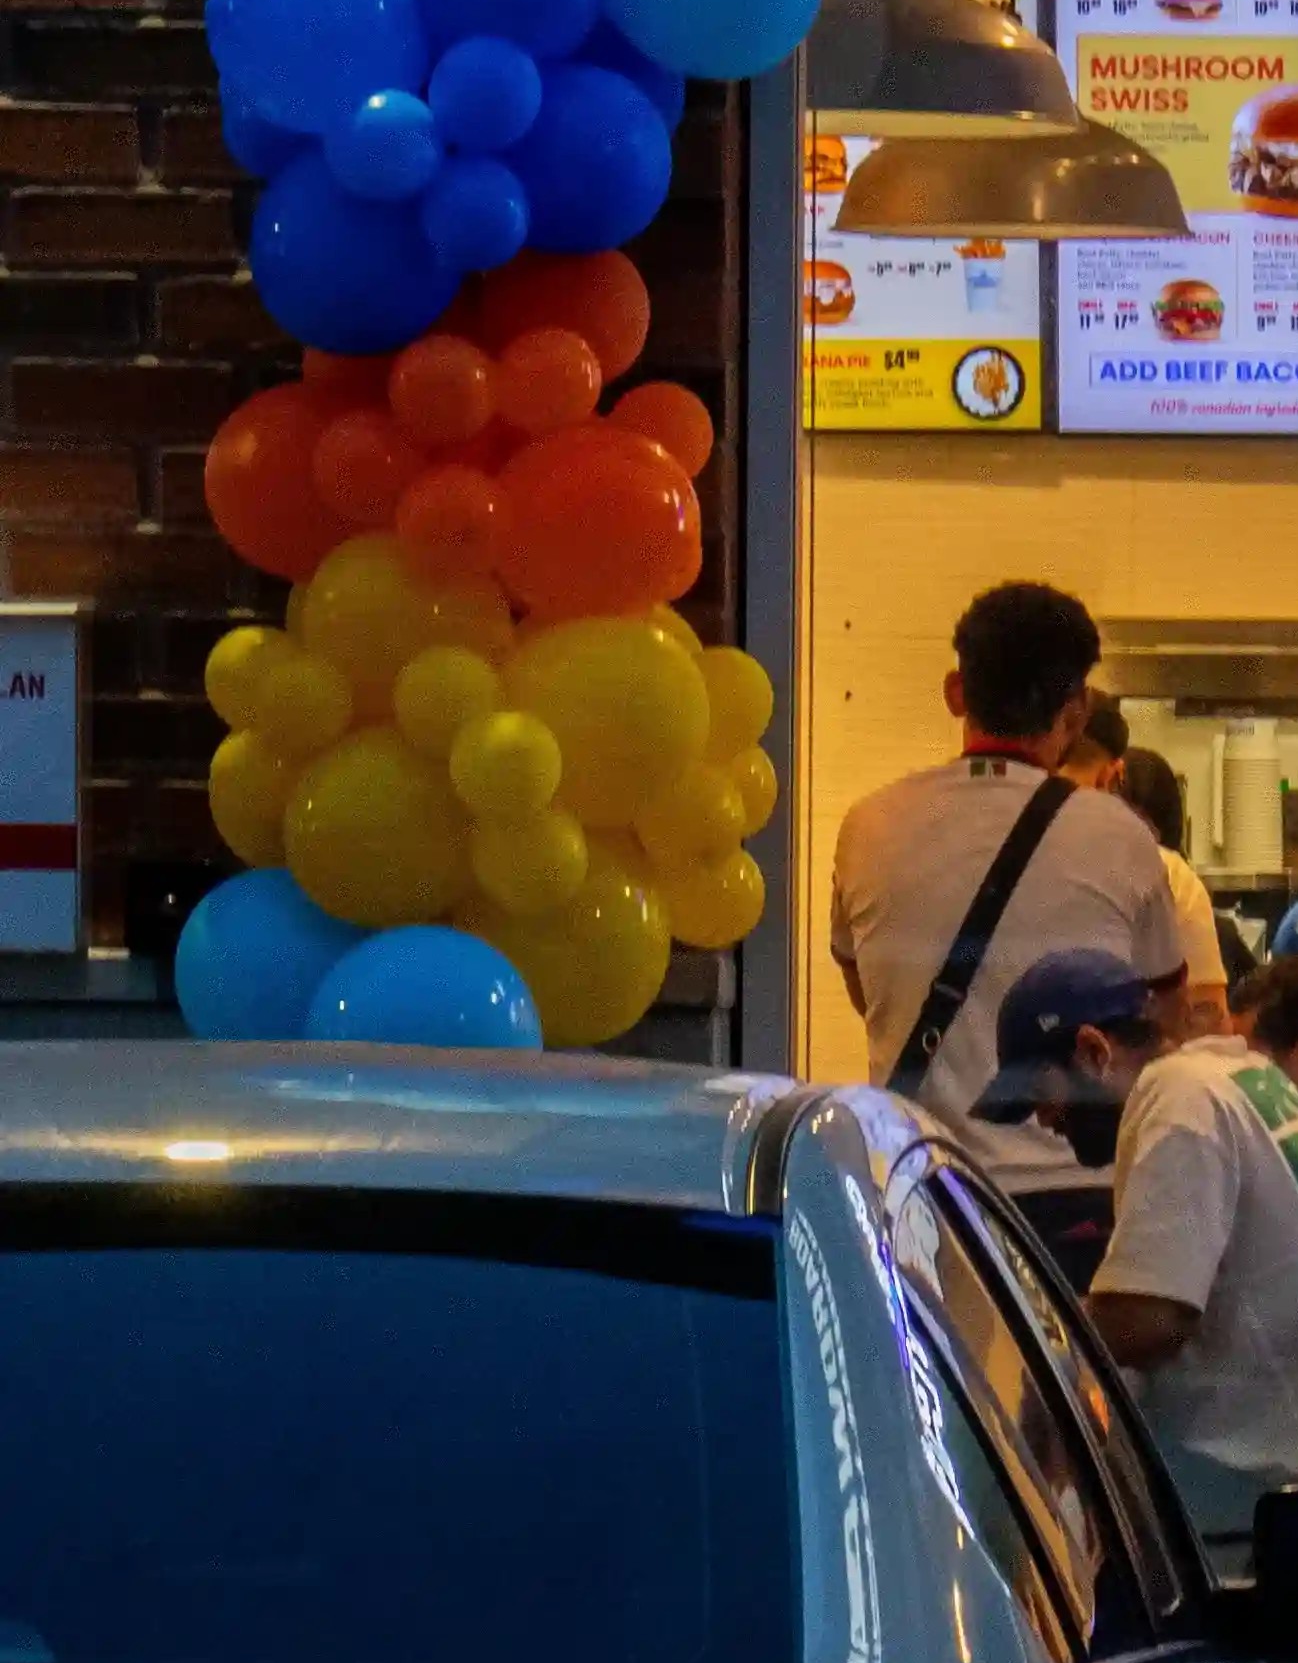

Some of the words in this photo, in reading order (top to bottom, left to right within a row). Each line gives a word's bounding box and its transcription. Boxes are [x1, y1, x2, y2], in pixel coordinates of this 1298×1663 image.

[1090, 55, 1285, 82] MUSHROOM
[1090, 87, 1189, 113] SWISS
[1099, 360, 1157, 383] ADD
[1165, 360, 1230, 383] BEEF
